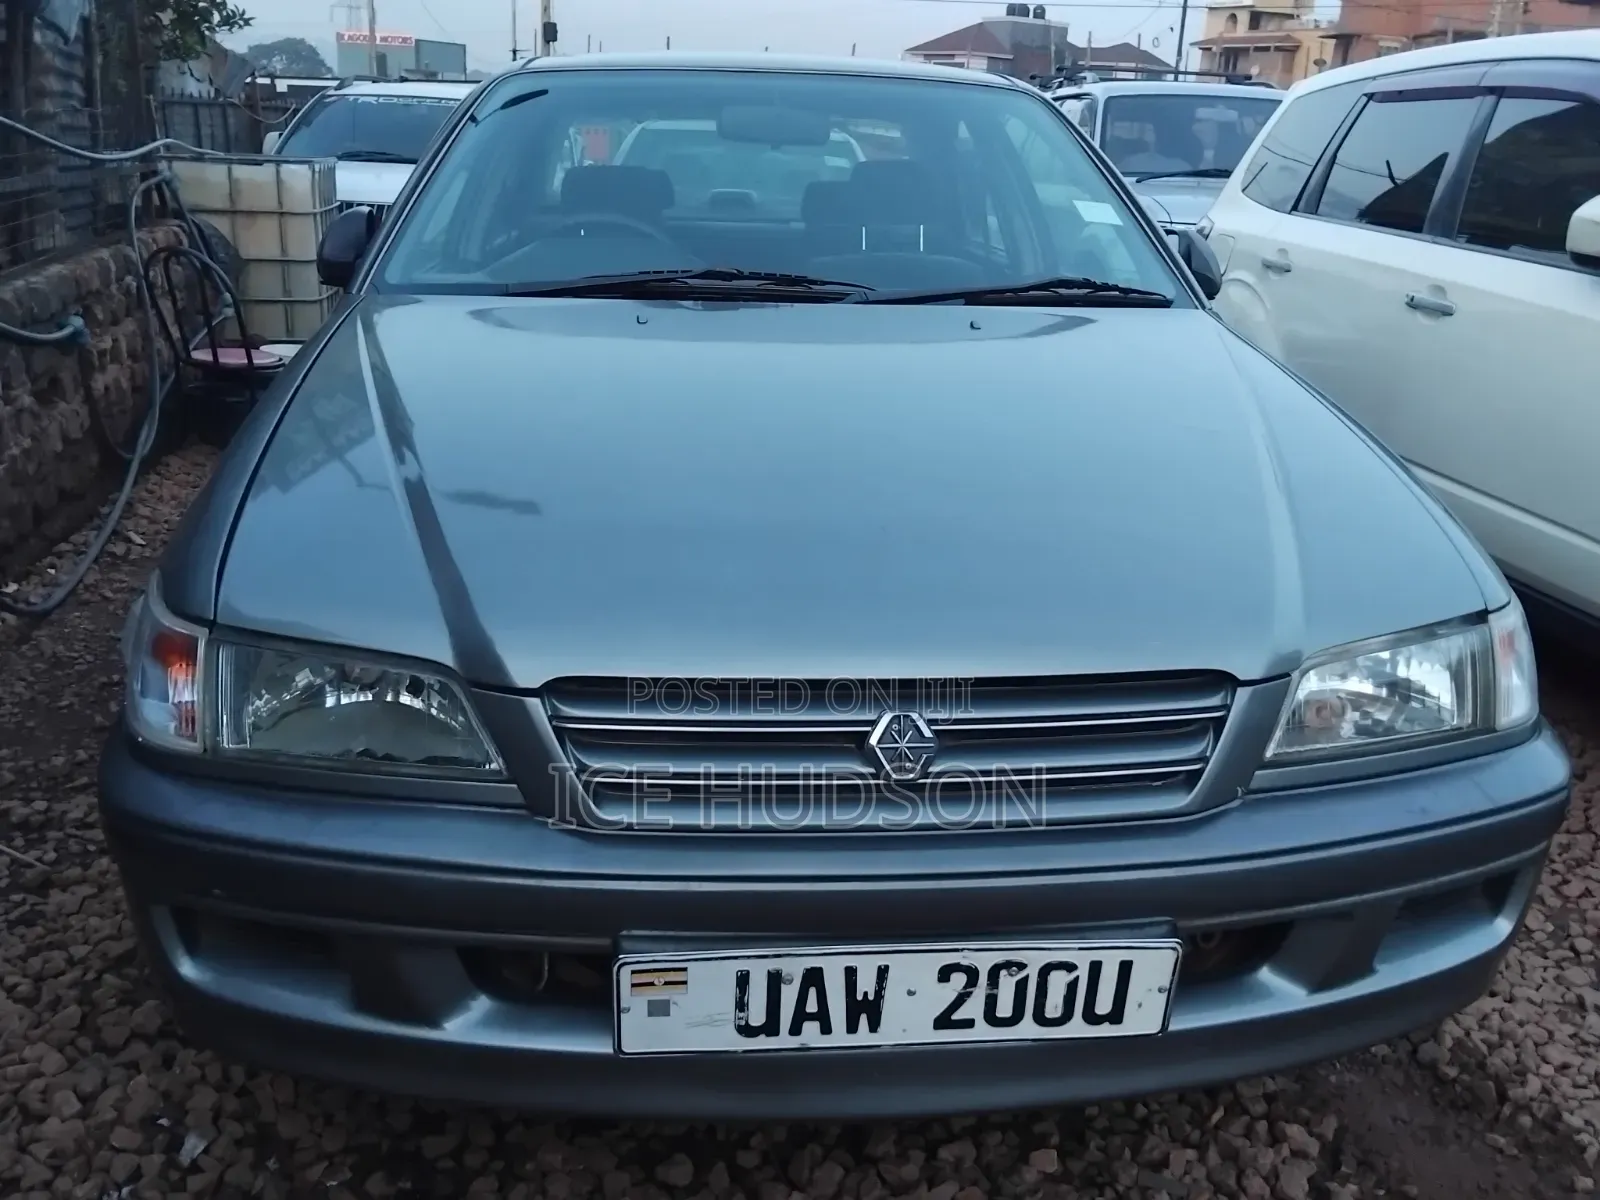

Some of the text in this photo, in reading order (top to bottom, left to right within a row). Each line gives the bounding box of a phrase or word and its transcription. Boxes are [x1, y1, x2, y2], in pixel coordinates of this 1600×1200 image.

[380, 35, 414, 45] MOTORS
[734, 959, 1134, 1038] UAW 200U
